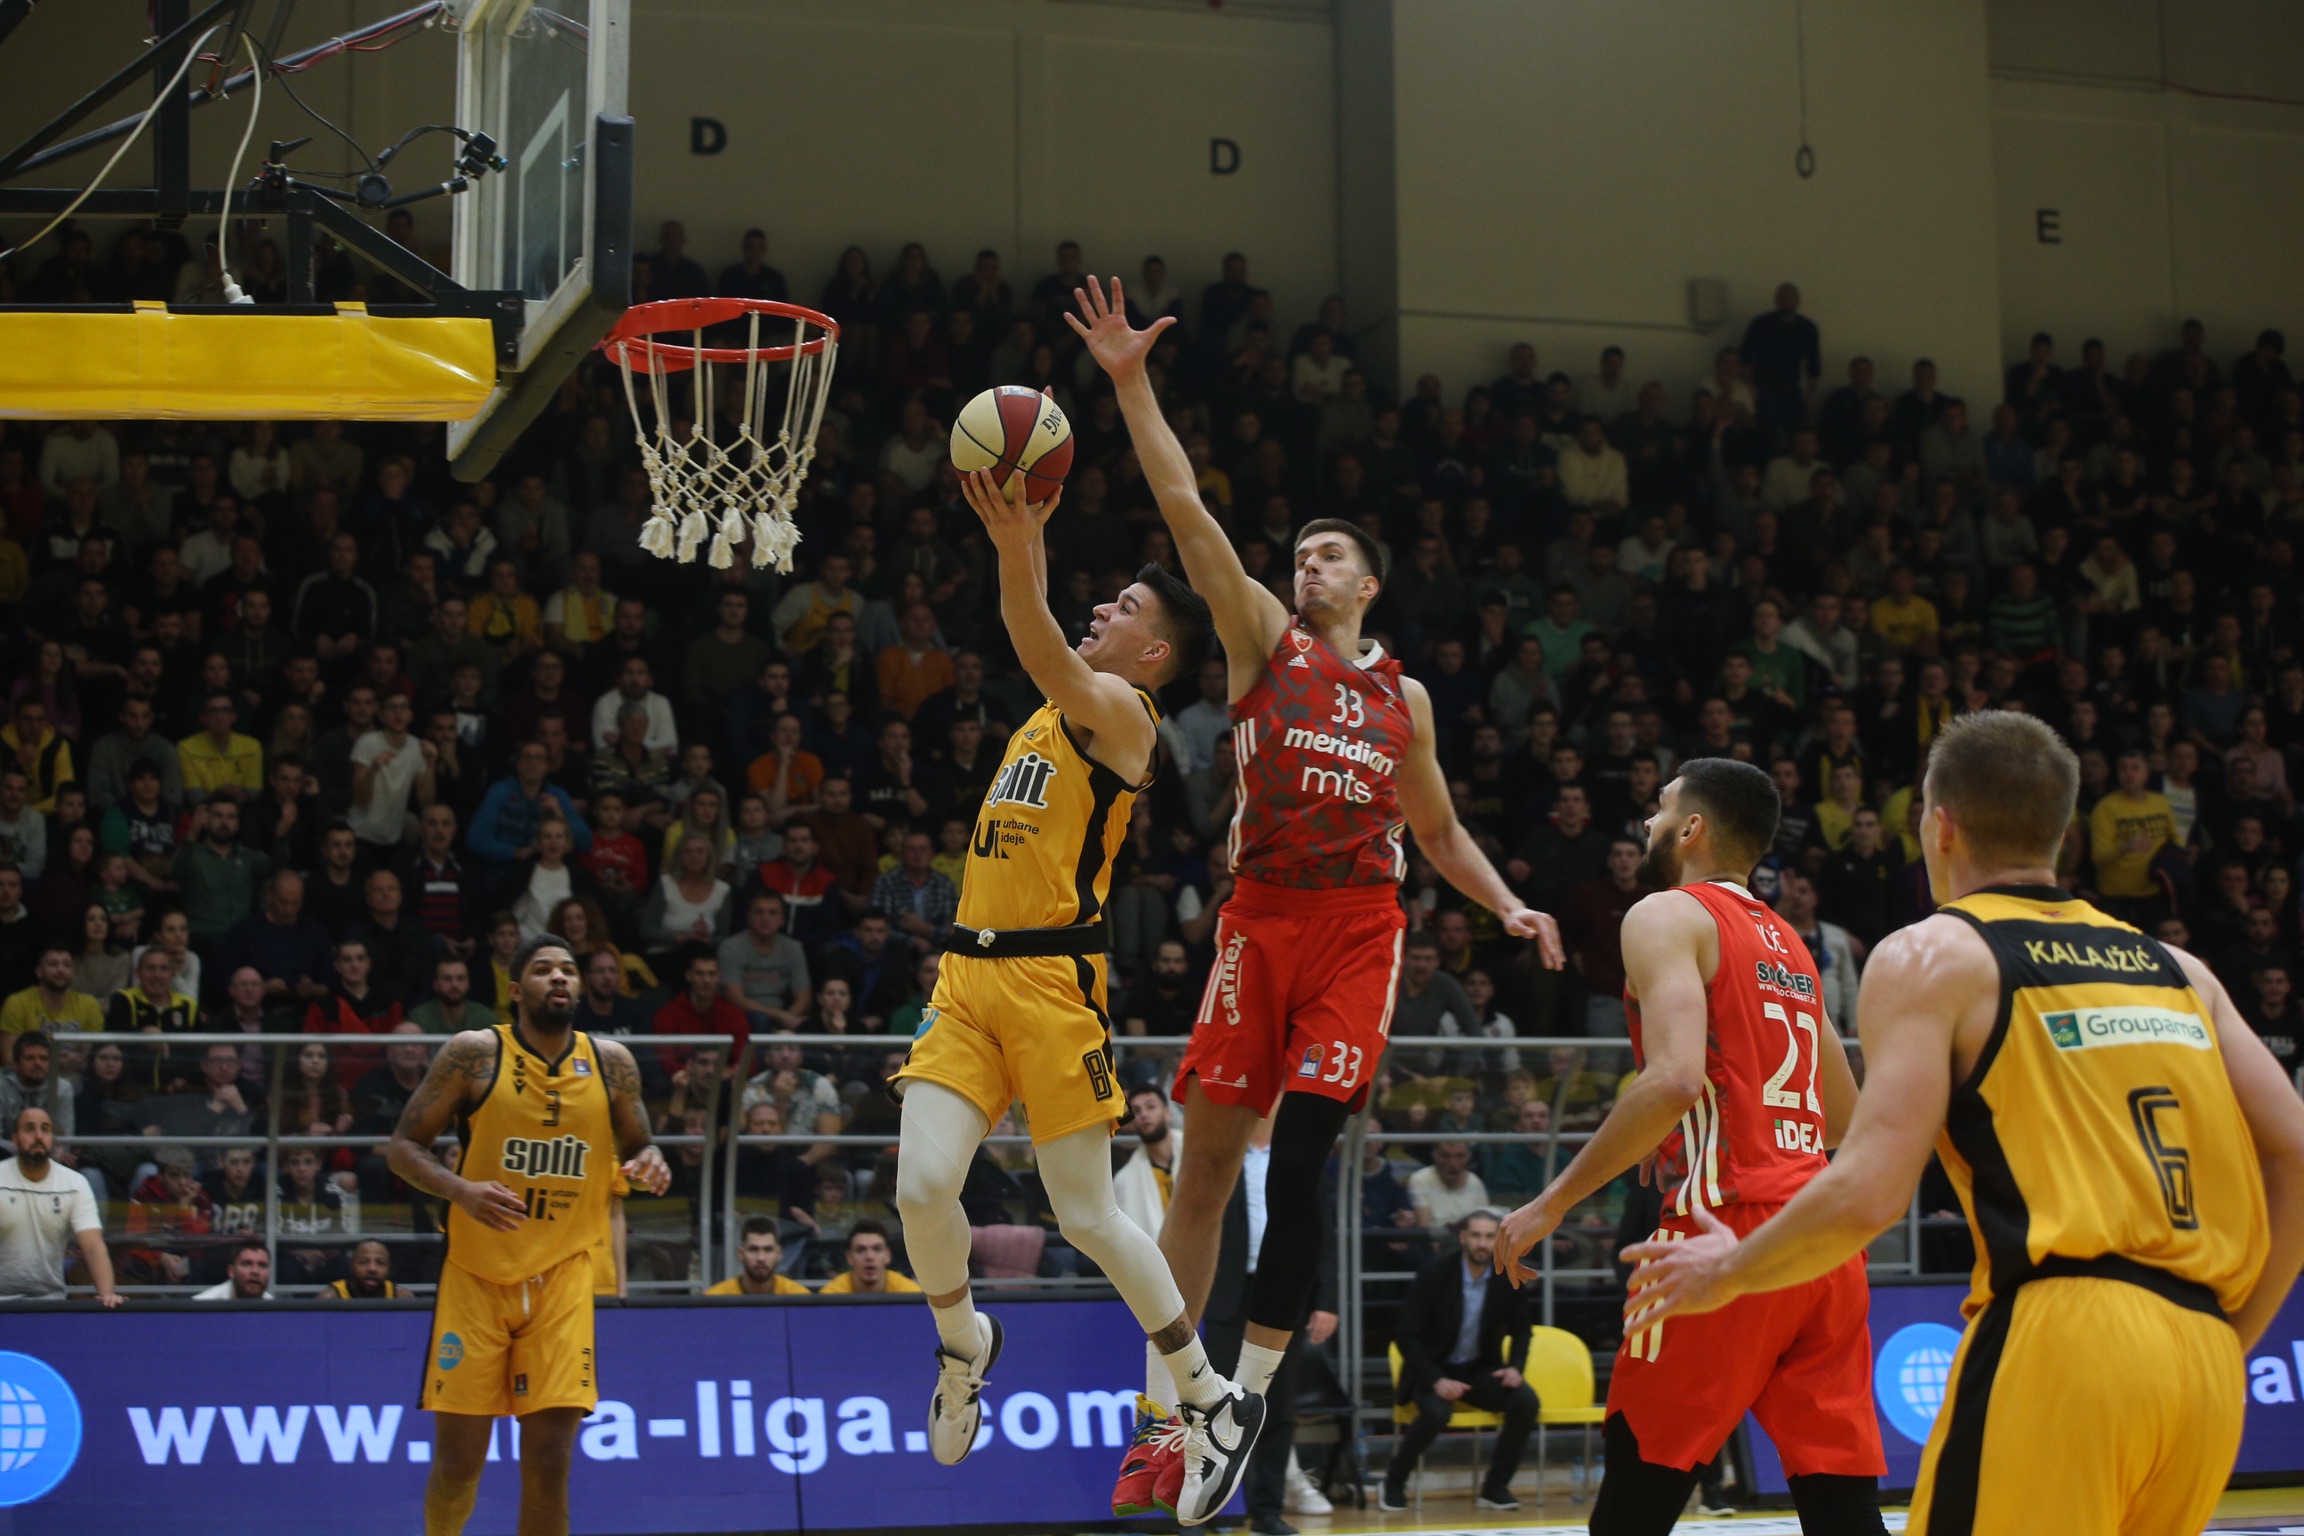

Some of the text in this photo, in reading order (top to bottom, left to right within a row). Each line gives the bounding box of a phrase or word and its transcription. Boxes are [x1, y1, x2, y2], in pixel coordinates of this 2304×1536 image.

[691, 118, 727, 155] D
[1210, 138, 1241, 174] D
[2037, 209, 2061, 244] E
[1331, 683, 1365, 728] 33
[1283, 727, 1394, 776] meridian
[1301, 766, 1373, 804] mts
[1001, 832, 1025, 846] ideje
[1003, 818, 1040, 835] urbane
[2024, 940, 2160, 972] KALAJŽIĆ
[1221, 931, 1248, 1026] carnex
[2086, 1014, 2205, 1041] Groupama
[1323, 1040, 1364, 1088] 33
[1762, 1001, 1823, 1118] 22
[541, 1090, 561, 1127] 3
[503, 1133, 592, 1179] split
[2127, 1085, 2200, 1231] 6
